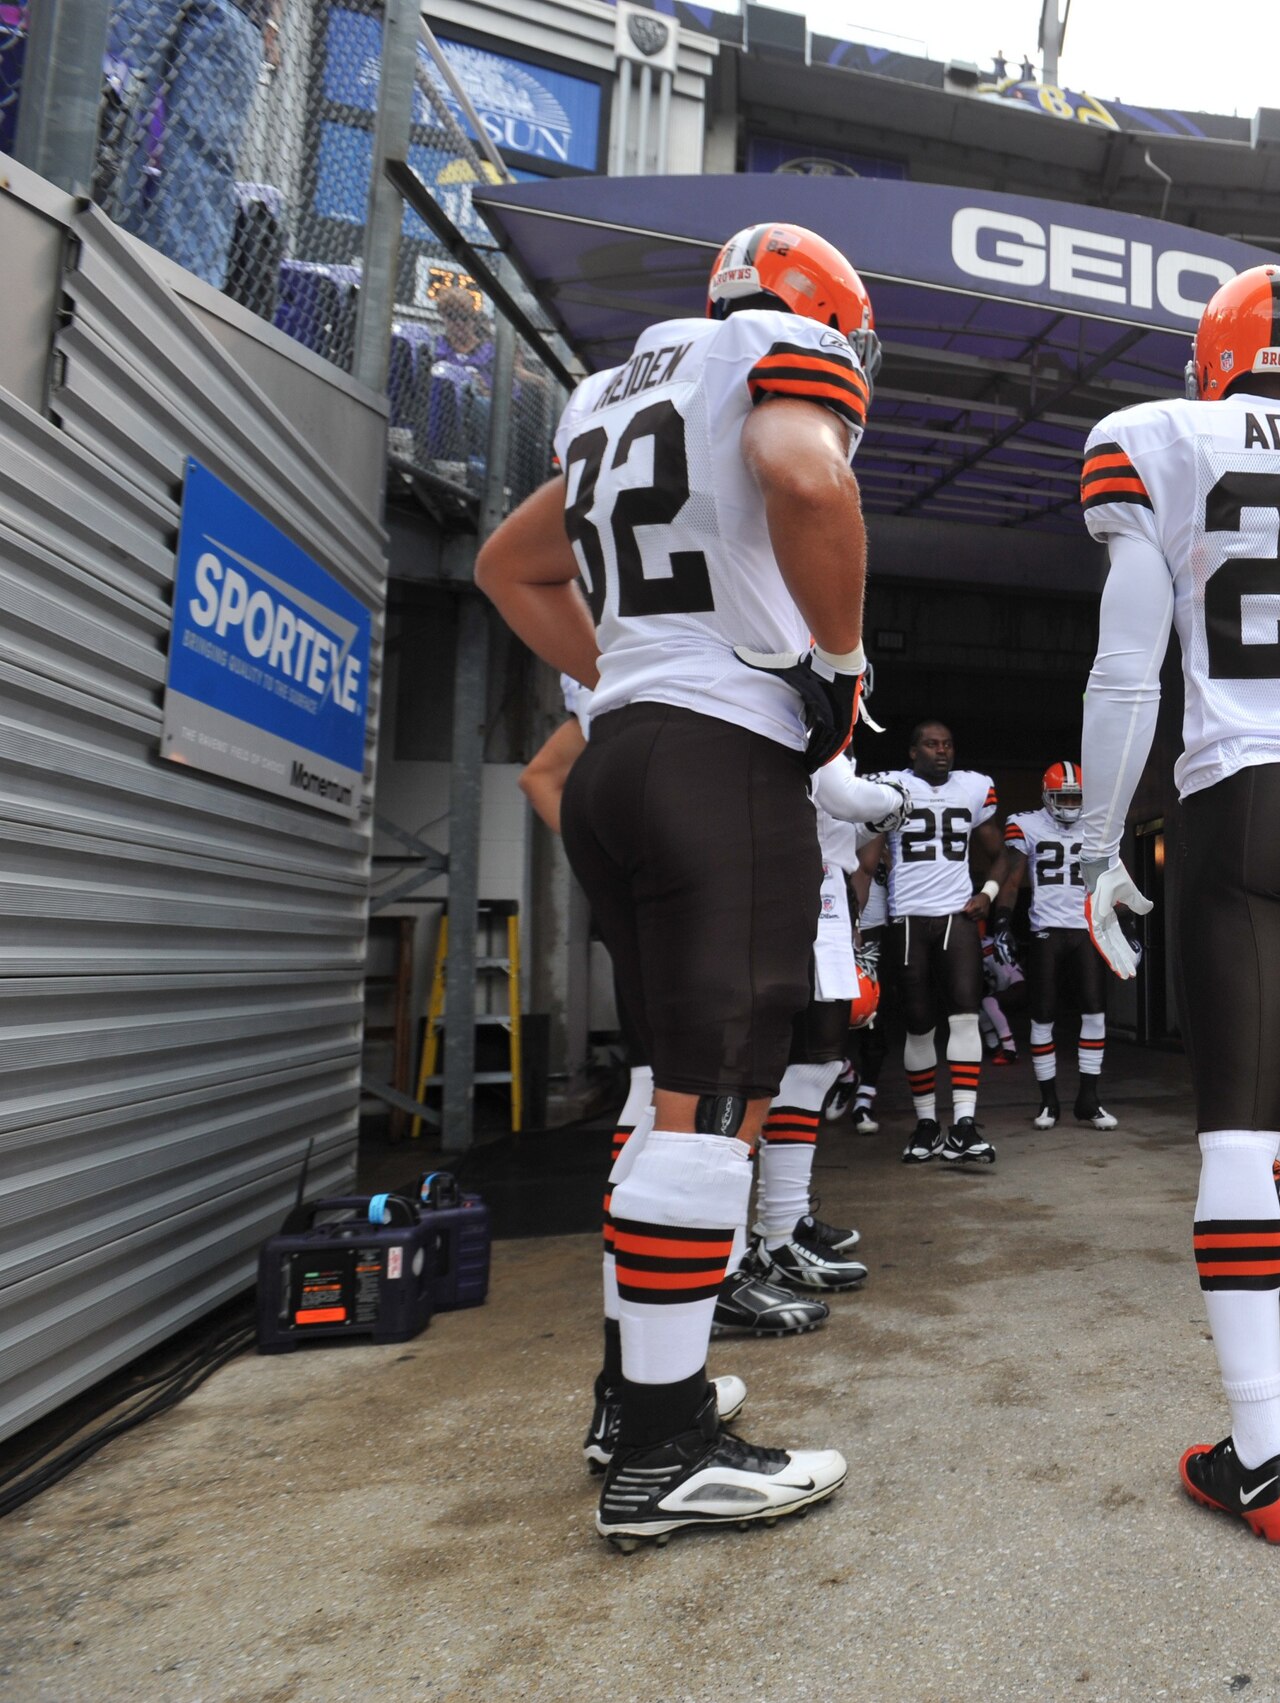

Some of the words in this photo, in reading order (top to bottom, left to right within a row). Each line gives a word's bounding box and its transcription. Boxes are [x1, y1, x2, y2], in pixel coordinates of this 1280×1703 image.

[478, 110, 572, 162] SUN
[951, 206, 1238, 320] GEIC
[564, 399, 715, 629] 82
[189, 552, 361, 713] SPORTEXE
[901, 807, 972, 863] 26
